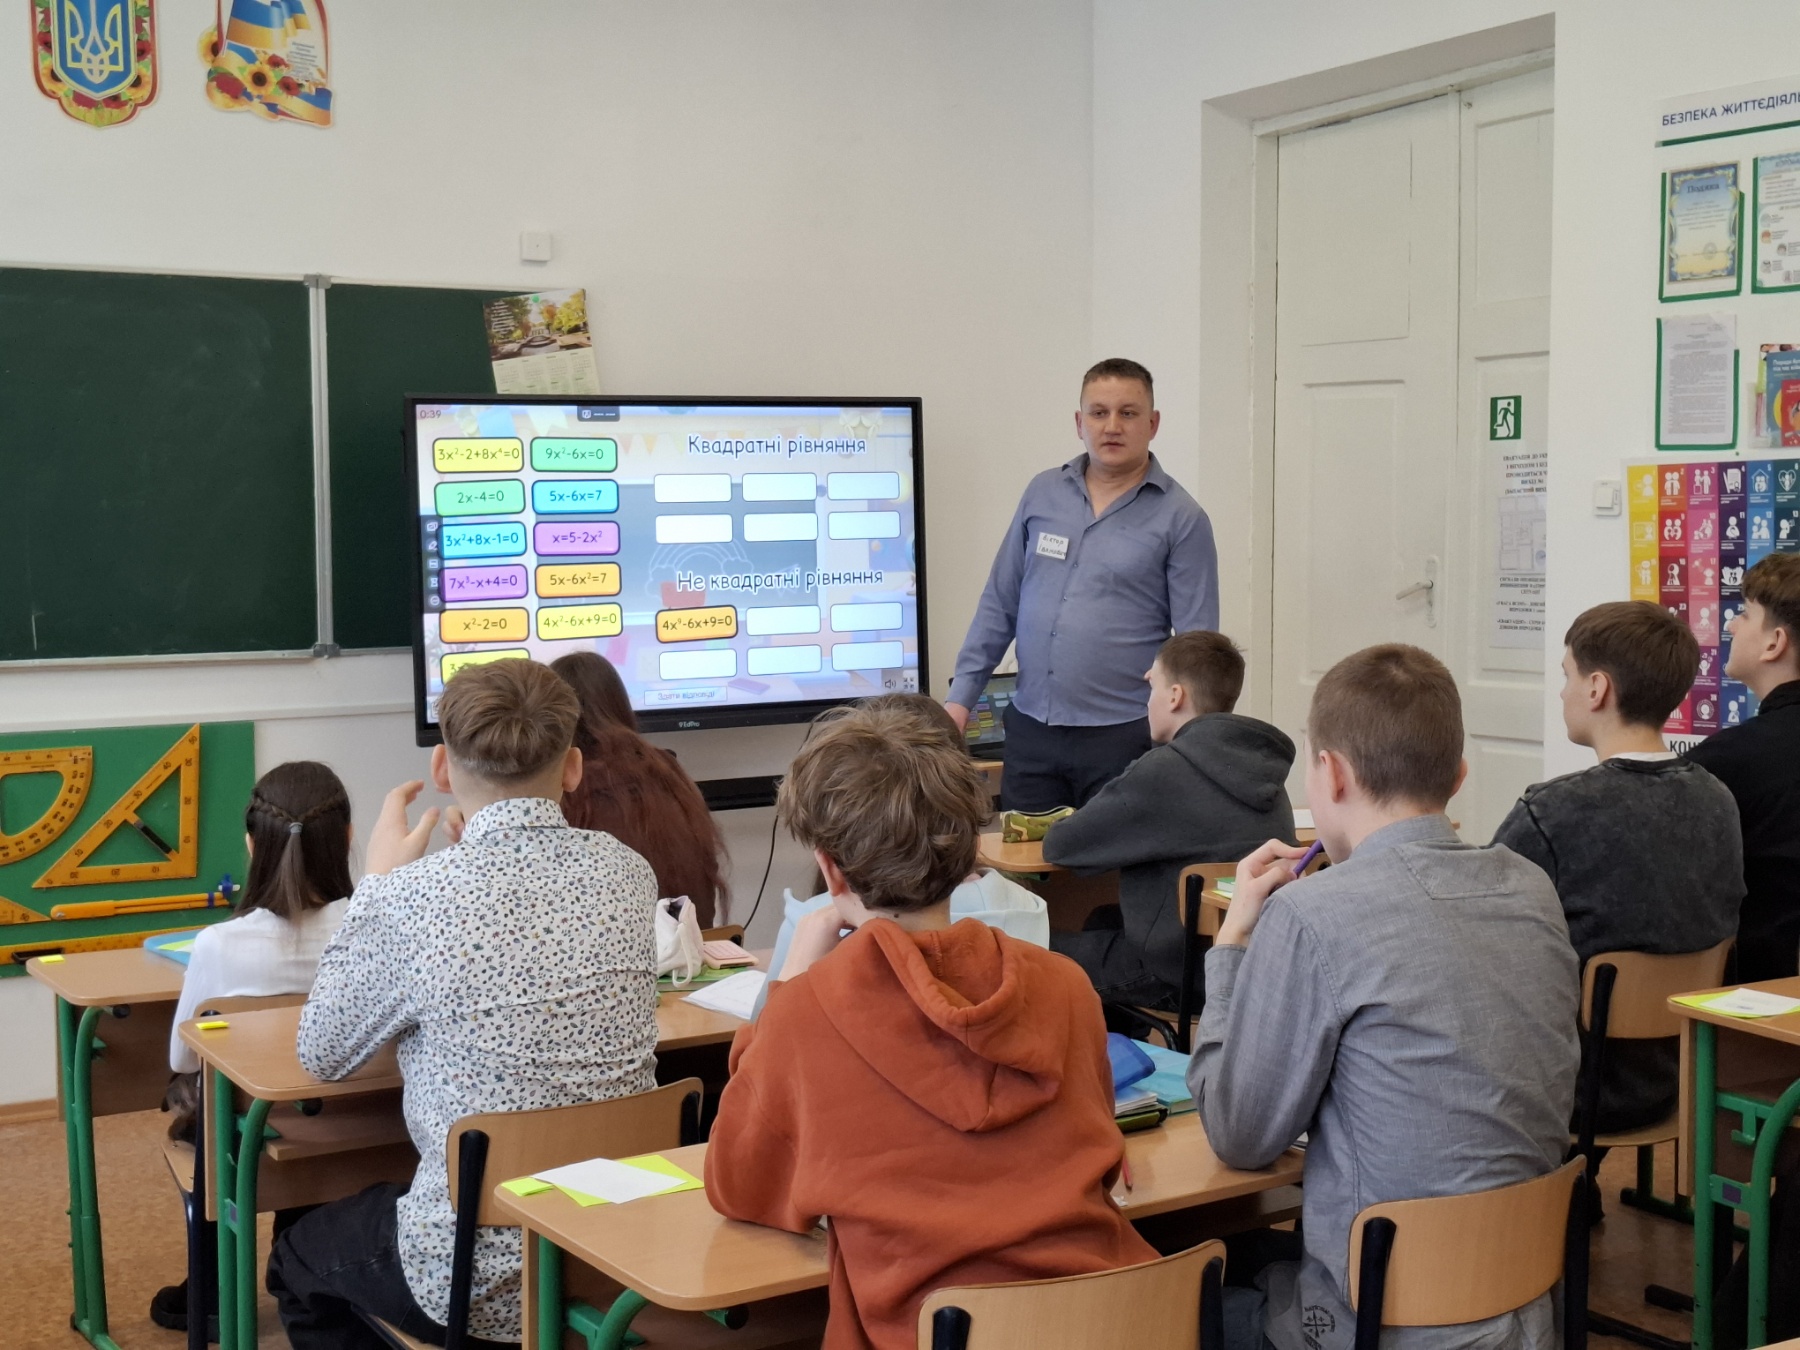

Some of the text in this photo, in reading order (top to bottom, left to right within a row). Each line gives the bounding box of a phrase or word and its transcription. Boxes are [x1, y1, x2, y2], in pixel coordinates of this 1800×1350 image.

[1661, 105, 1718, 127] БЕЗПЕКА
[419, 410, 442, 419] 0:39
[687, 435, 866, 459] Квадратні рівняння
[457, 490, 505, 504] 2x-4=0
[549, 490, 602, 502] 5x-6x=7
[676, 568, 884, 594] Не квадратні рівняння
[74, 848, 84, 858] 10
